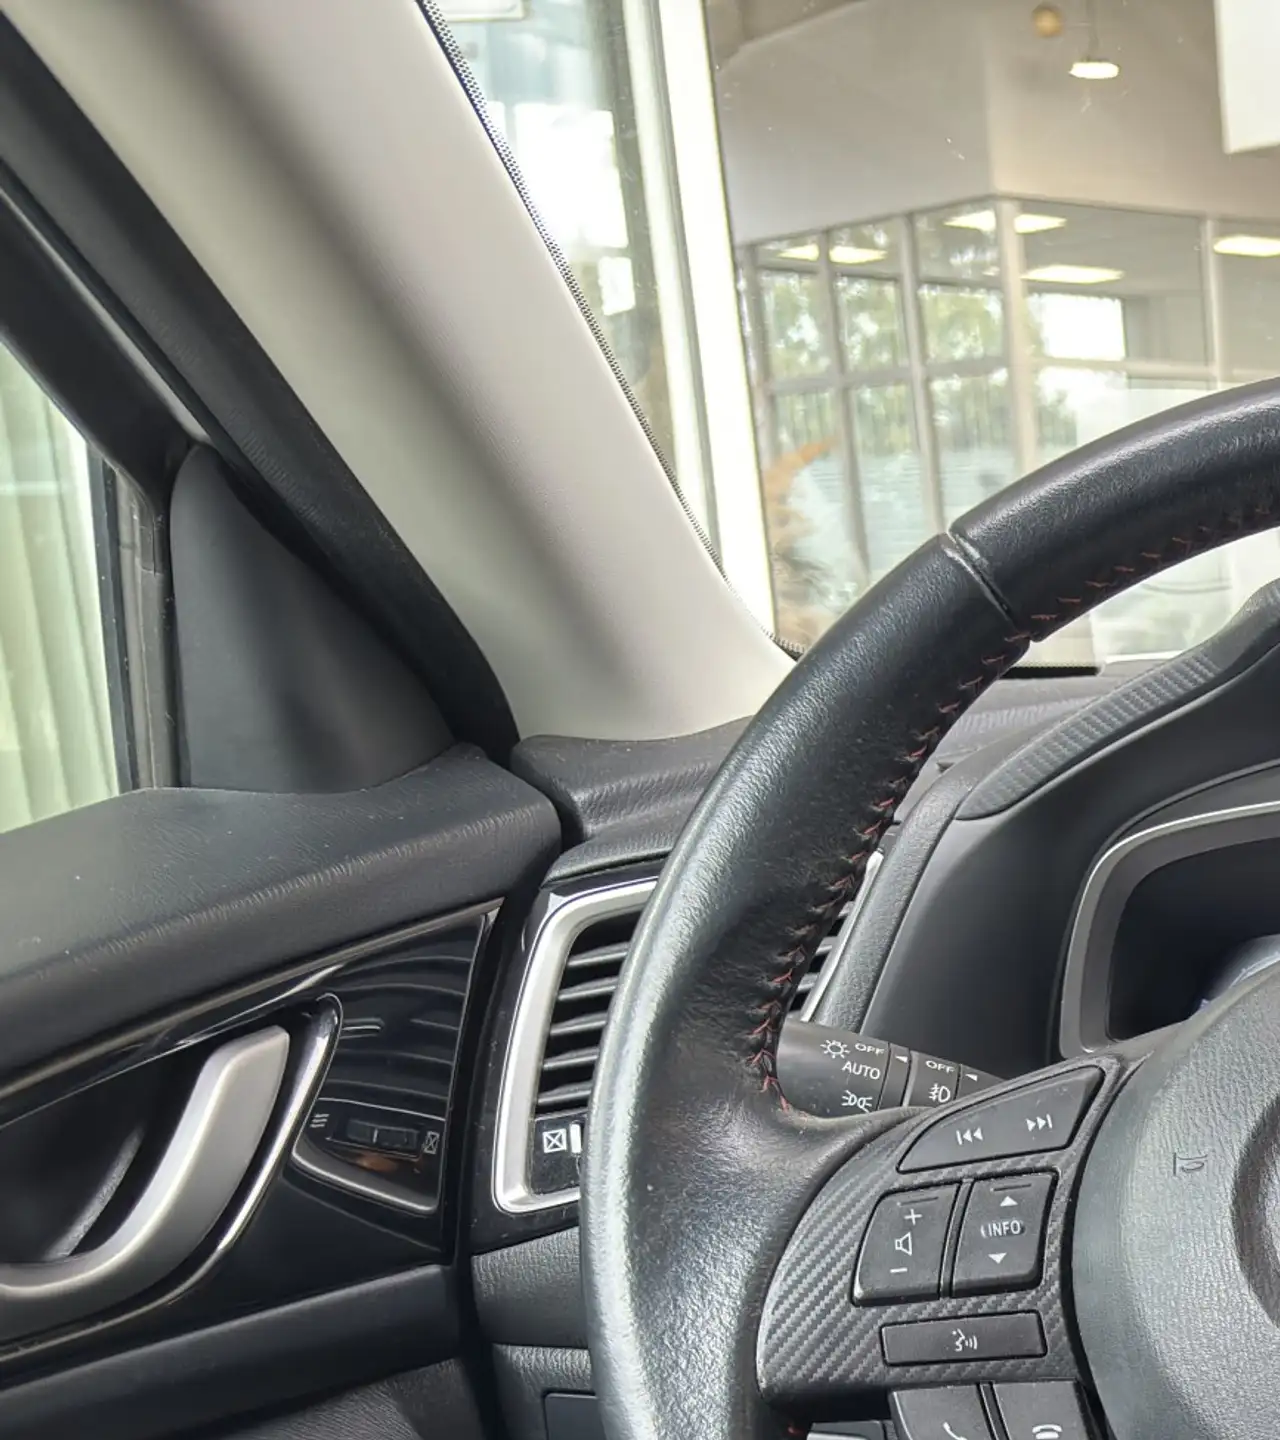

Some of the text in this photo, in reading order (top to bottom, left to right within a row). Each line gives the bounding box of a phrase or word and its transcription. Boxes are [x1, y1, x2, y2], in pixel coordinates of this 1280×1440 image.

[854, 1042, 884, 1054] OFF
[842, 1060, 881, 1080] AUTO
[925, 1060, 955, 1073] OFF
